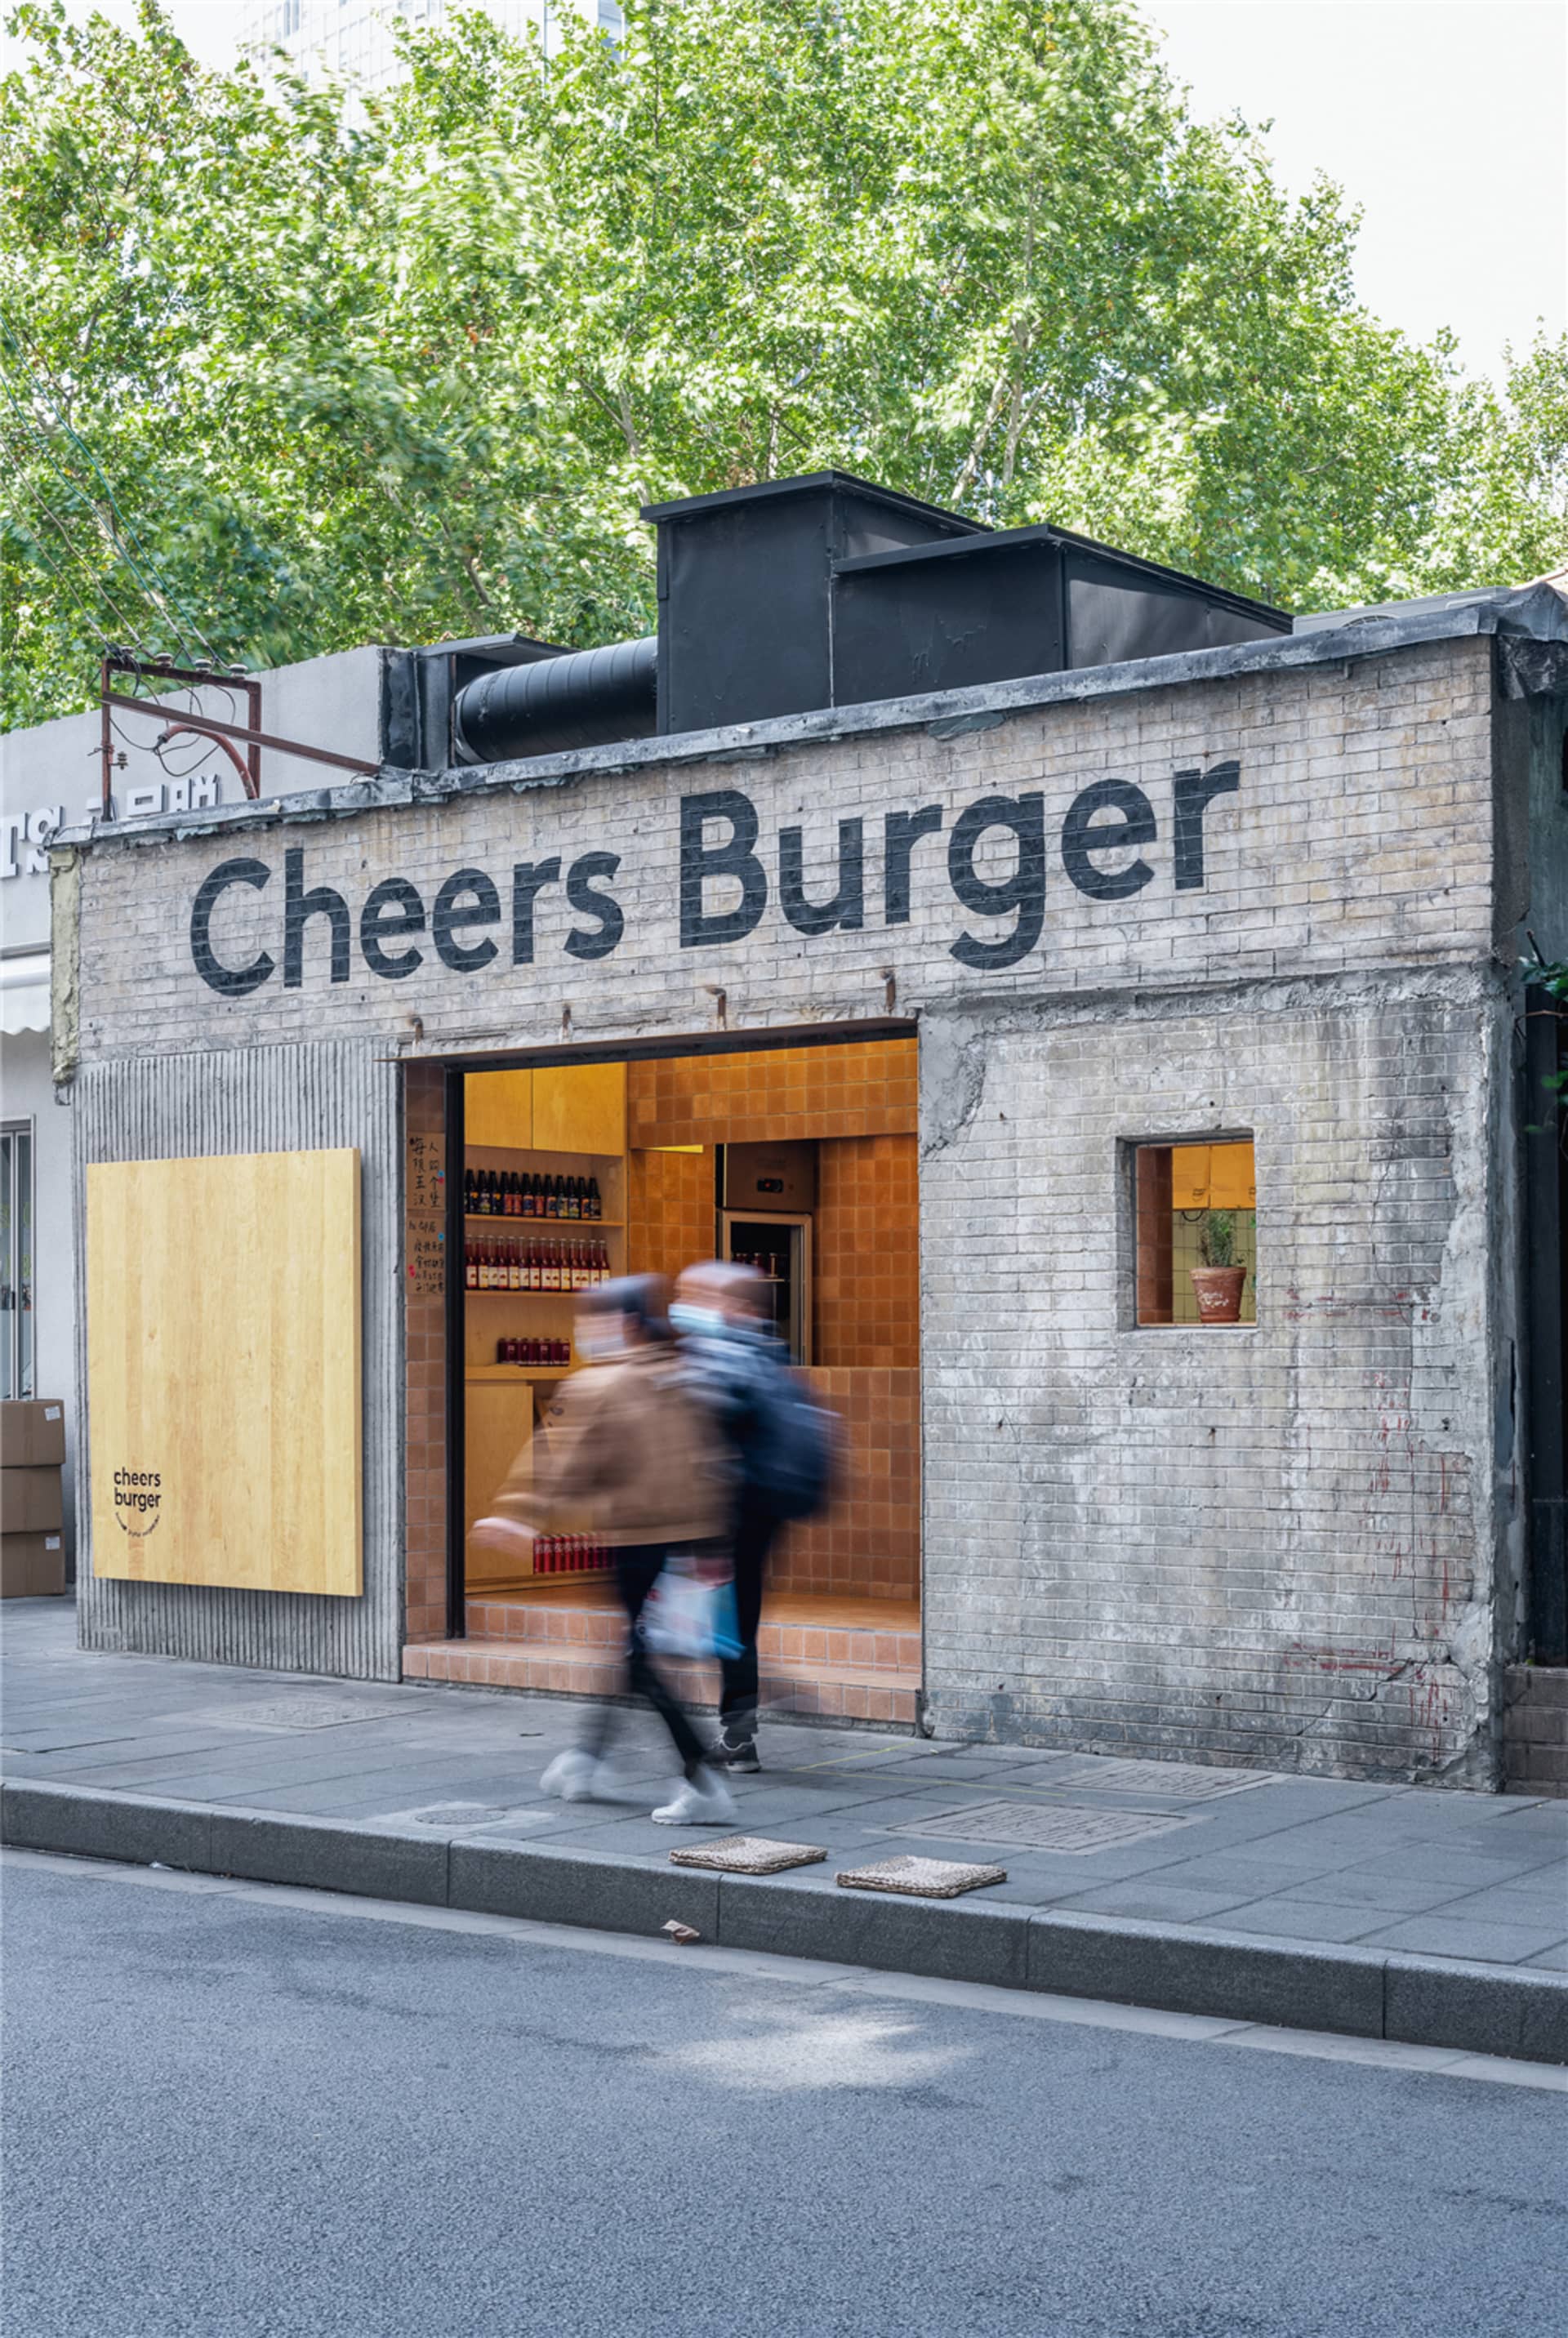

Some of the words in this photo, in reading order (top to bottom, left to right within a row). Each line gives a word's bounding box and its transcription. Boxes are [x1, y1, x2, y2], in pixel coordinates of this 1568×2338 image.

[189, 847, 625, 997] Cheers
[679, 760, 1241, 970] Burger
[114, 1466, 161, 1487] cheers
[114, 1486, 162, 1512] burger
